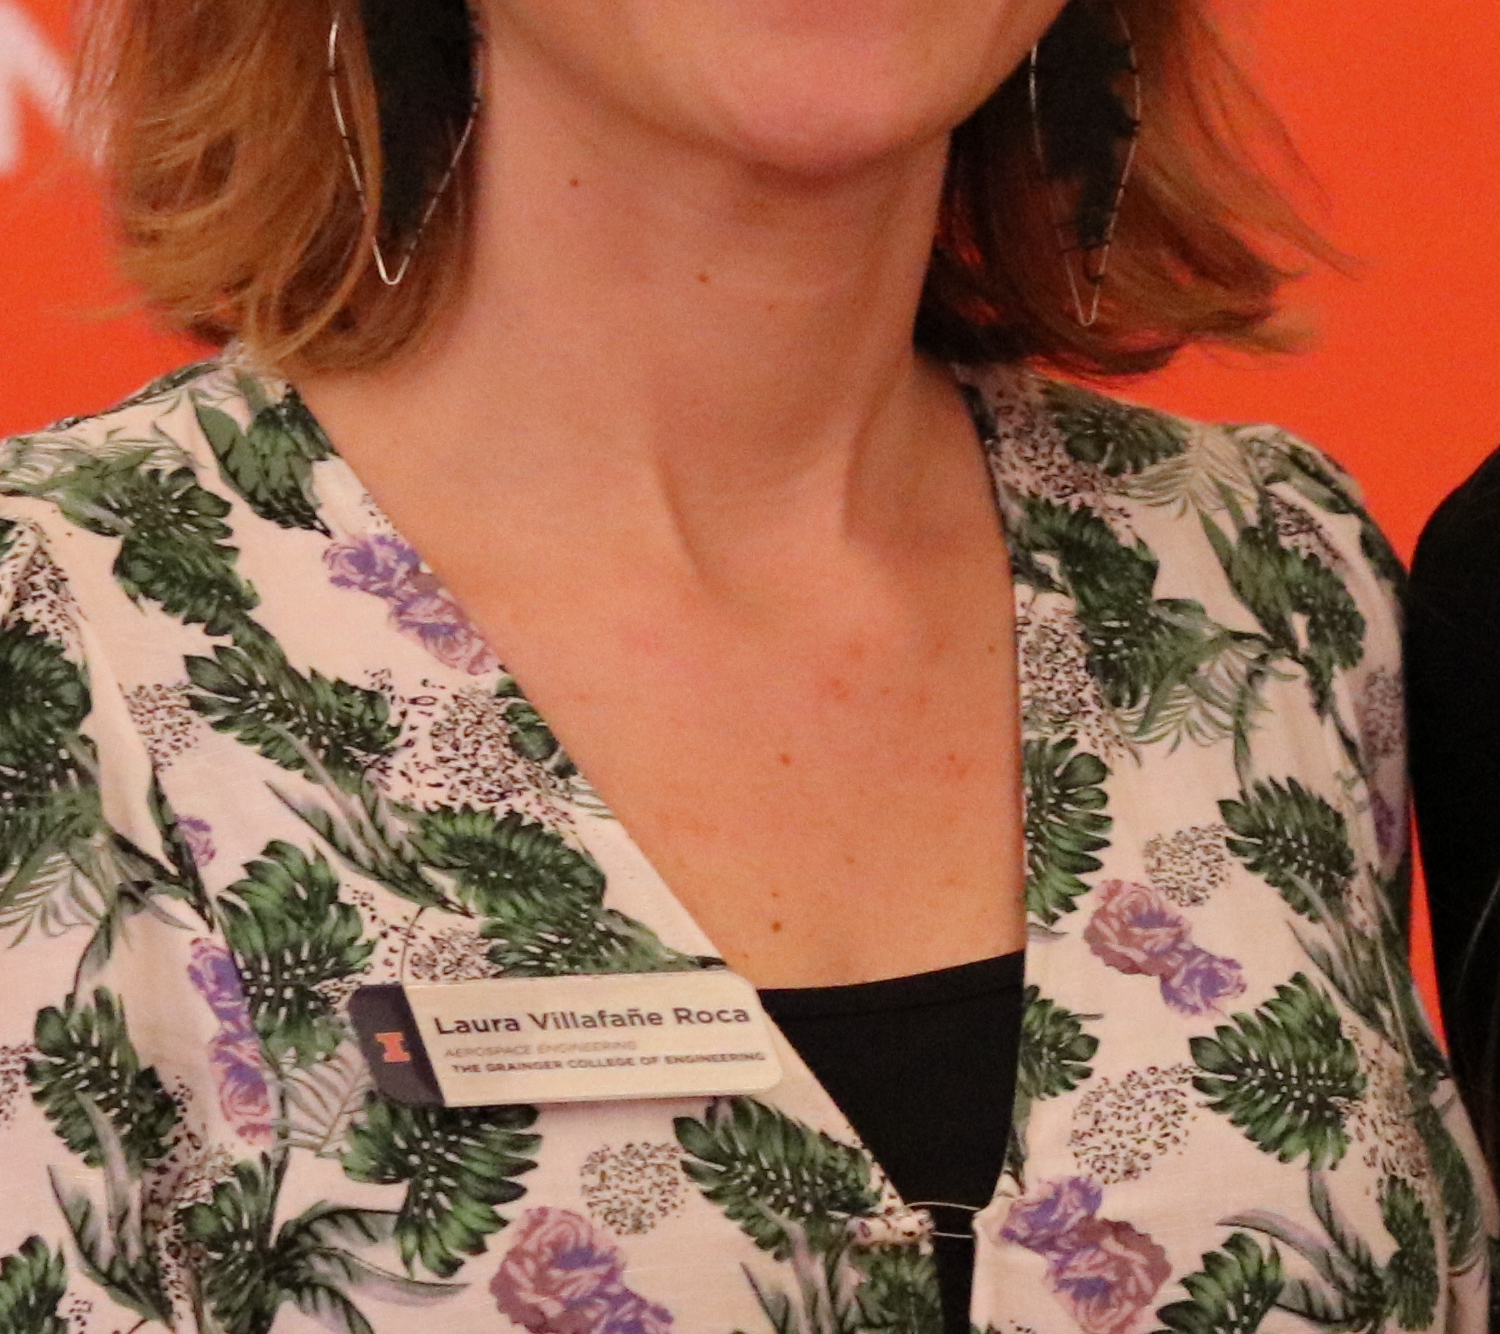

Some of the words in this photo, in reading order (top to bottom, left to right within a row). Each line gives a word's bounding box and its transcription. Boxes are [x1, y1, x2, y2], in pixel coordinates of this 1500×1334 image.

[433, 1016, 521, 1035] Laura
[527, 1008, 664, 1031] Villafañe
[673, 1006, 750, 1026] Roca
[452, 1063, 482, 1074] THE
[484, 1059, 562, 1073] GRAINGER
[567, 1056, 636, 1069] COLLEGE
[639, 1055, 659, 1066] OF
[664, 1052, 767, 1065] ENGINEERING
